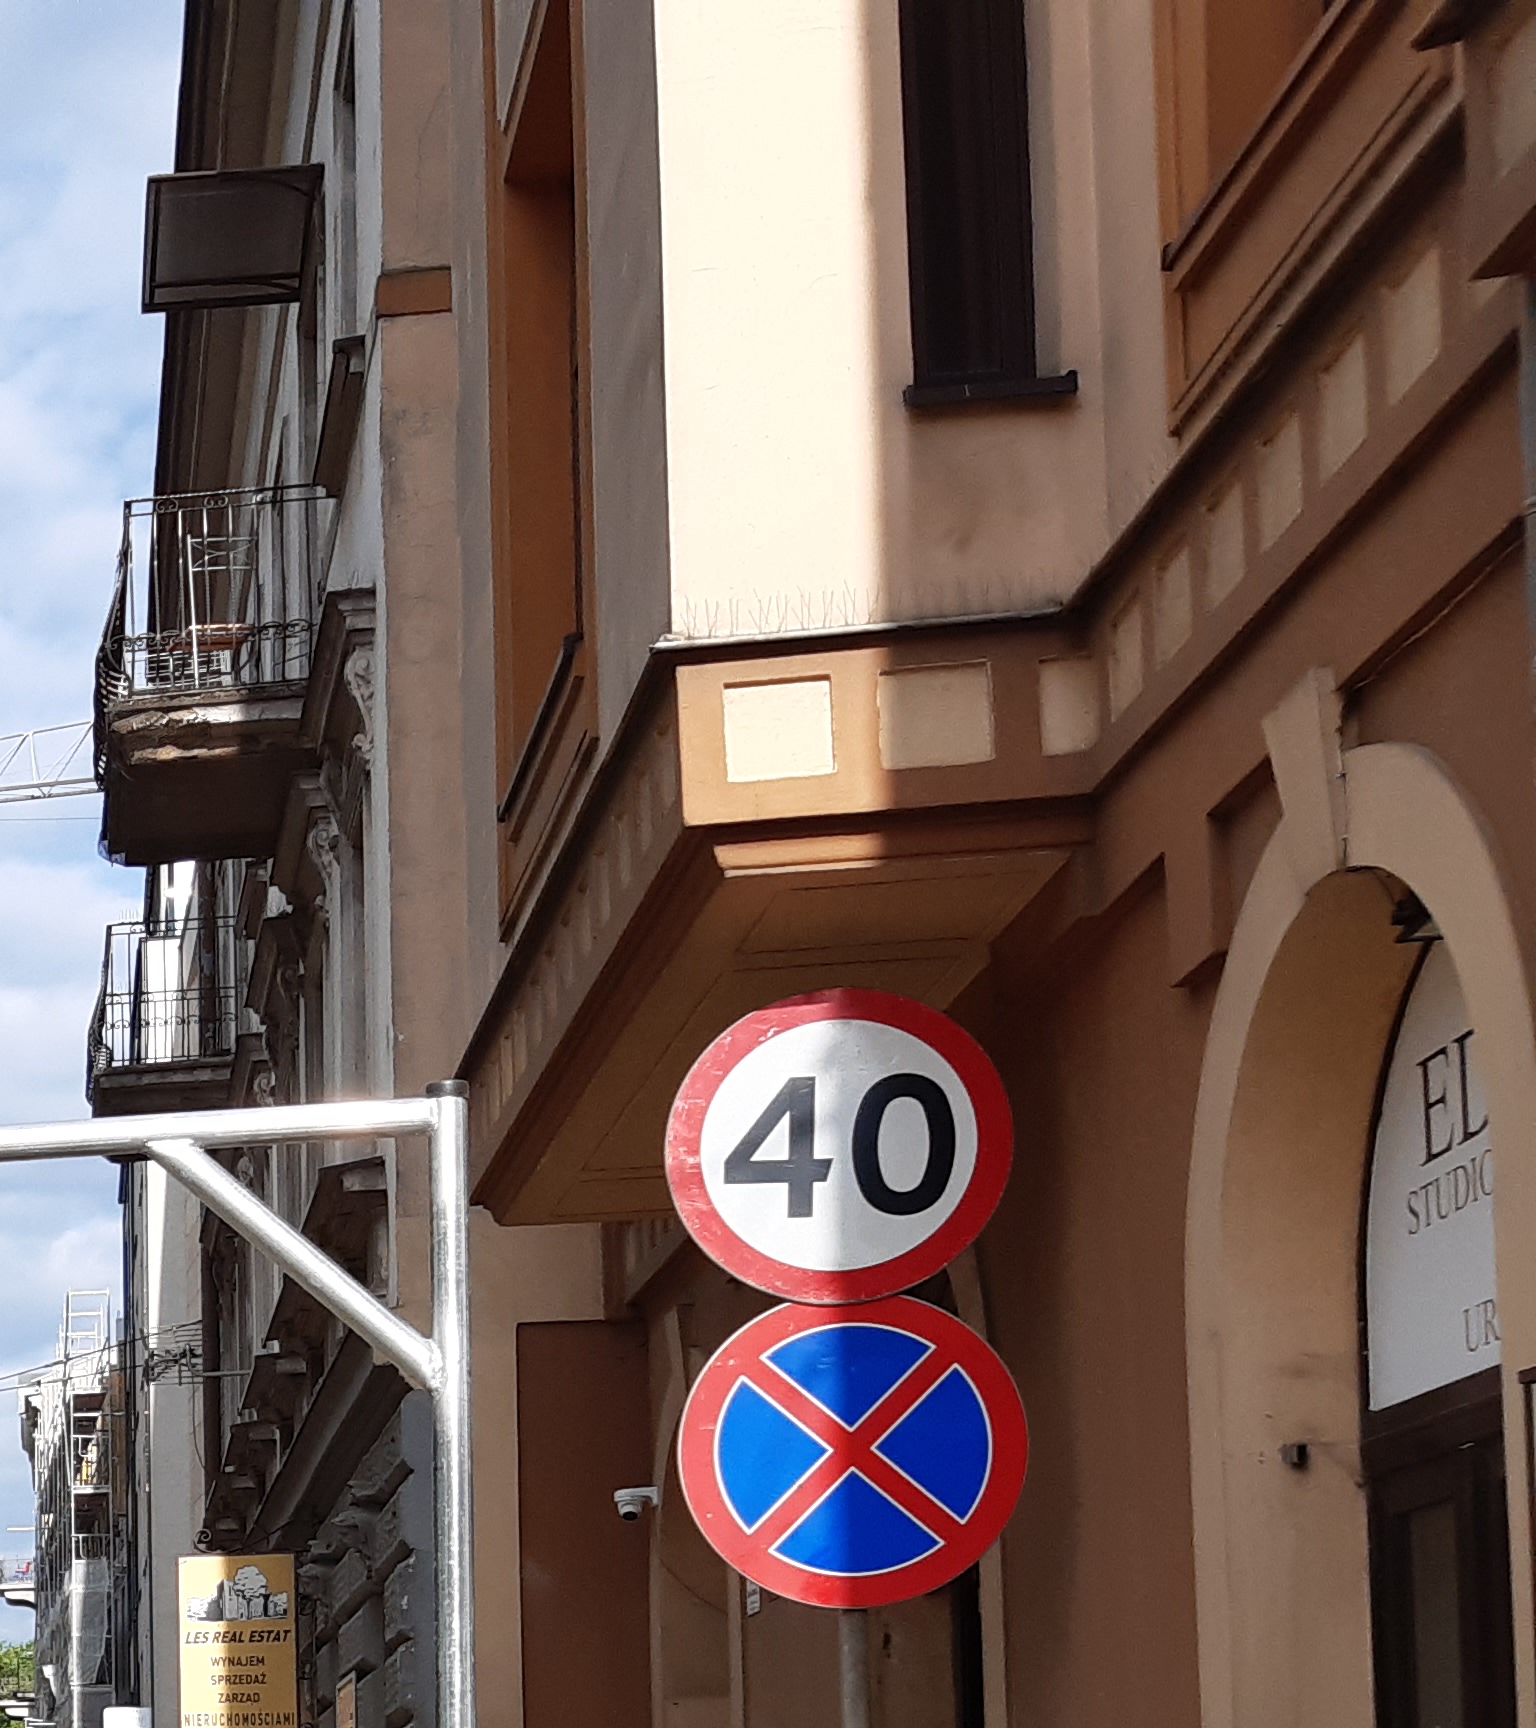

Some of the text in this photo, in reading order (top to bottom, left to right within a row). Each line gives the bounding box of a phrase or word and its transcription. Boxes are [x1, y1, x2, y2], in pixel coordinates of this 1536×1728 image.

[723, 1072, 956, 1218] 40
[185, 1629, 291, 1644] LES REAL ESTAT
[210, 1655, 266, 1667] WYNAJEM
[210, 1671, 267, 1685] SPRZEDAŻ
[218, 1692, 261, 1705] ZARZĄD
[184, 1707, 295, 1727] NIERUCHOMOŚCIAMI
